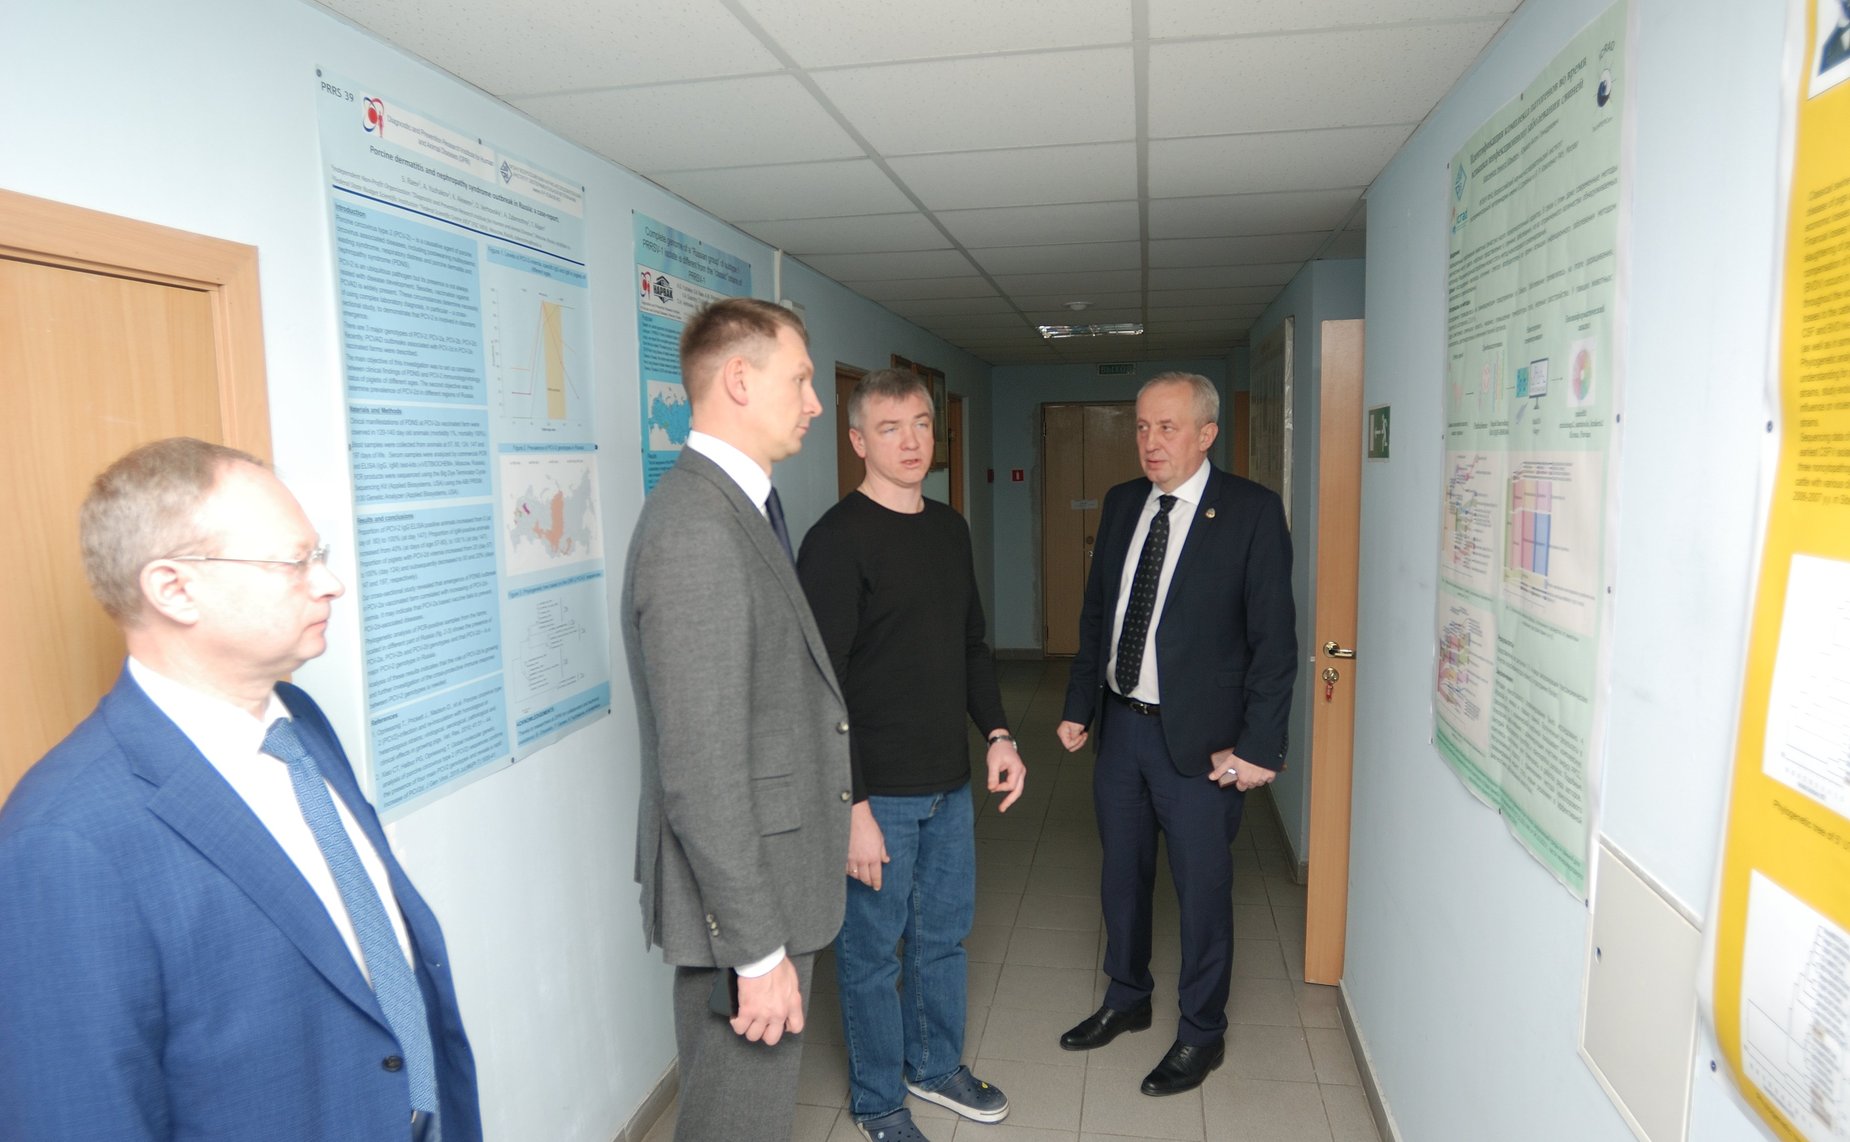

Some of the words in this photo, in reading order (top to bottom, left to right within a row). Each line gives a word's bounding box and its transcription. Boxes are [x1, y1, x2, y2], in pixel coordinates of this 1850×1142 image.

[321, 81, 342, 98] PRRS
[344, 90, 355, 103] 39
[369, 144, 393, 161] Porcine
[394, 153, 424, 172] dermatitis
[424, 165, 435, 176] and
[436, 170, 467, 189] nephropathy
[468, 182, 491, 198] syndrome
[492, 191, 512, 205] outbreak
[513, 199, 517, 207] in
[518, 201, 532, 213] Russia:
[537, 208, 559, 224] case-report.
